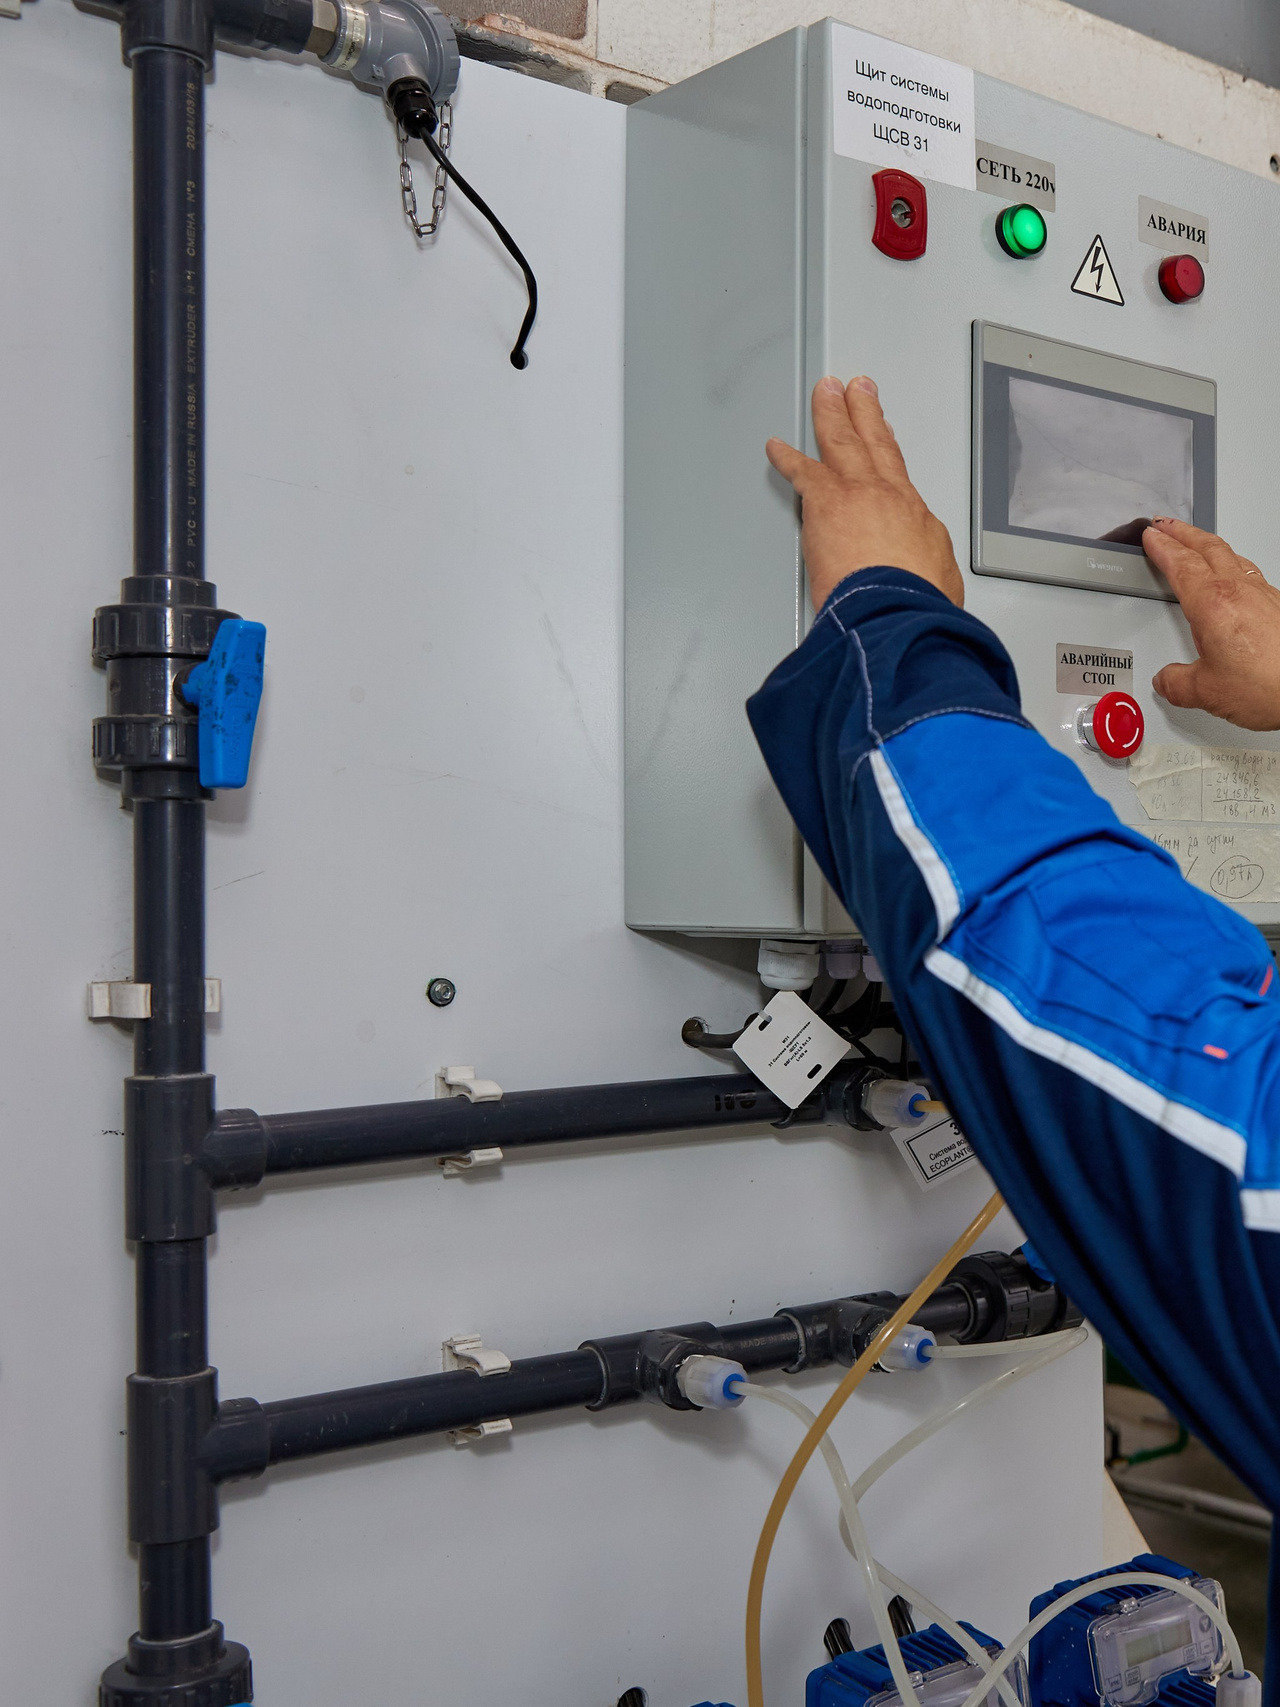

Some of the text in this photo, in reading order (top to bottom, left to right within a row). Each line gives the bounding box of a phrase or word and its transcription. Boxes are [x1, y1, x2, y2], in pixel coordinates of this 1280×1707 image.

[855, 59, 950, 102] Щит системы
[847, 89, 962, 134] водоподготовки
[873, 122, 929, 153] ЩСВ 31
[976, 156, 1022, 184] СЕТЬ
[1146, 213, 1207, 245] АВАРИЯ
[186, 304, 196, 374] EXTRUDER
[186, 383, 196, 429] RUSSIA
[186, 434, 196, 446] IN
[186, 450, 196, 487] MADE
[186, 520, 196, 547] PVC
[1060, 652, 1133, 670] АВАРИЙНЫЙ
[1082, 671, 1115, 686] СТОП
[929, 1143, 957, 1161] Система
